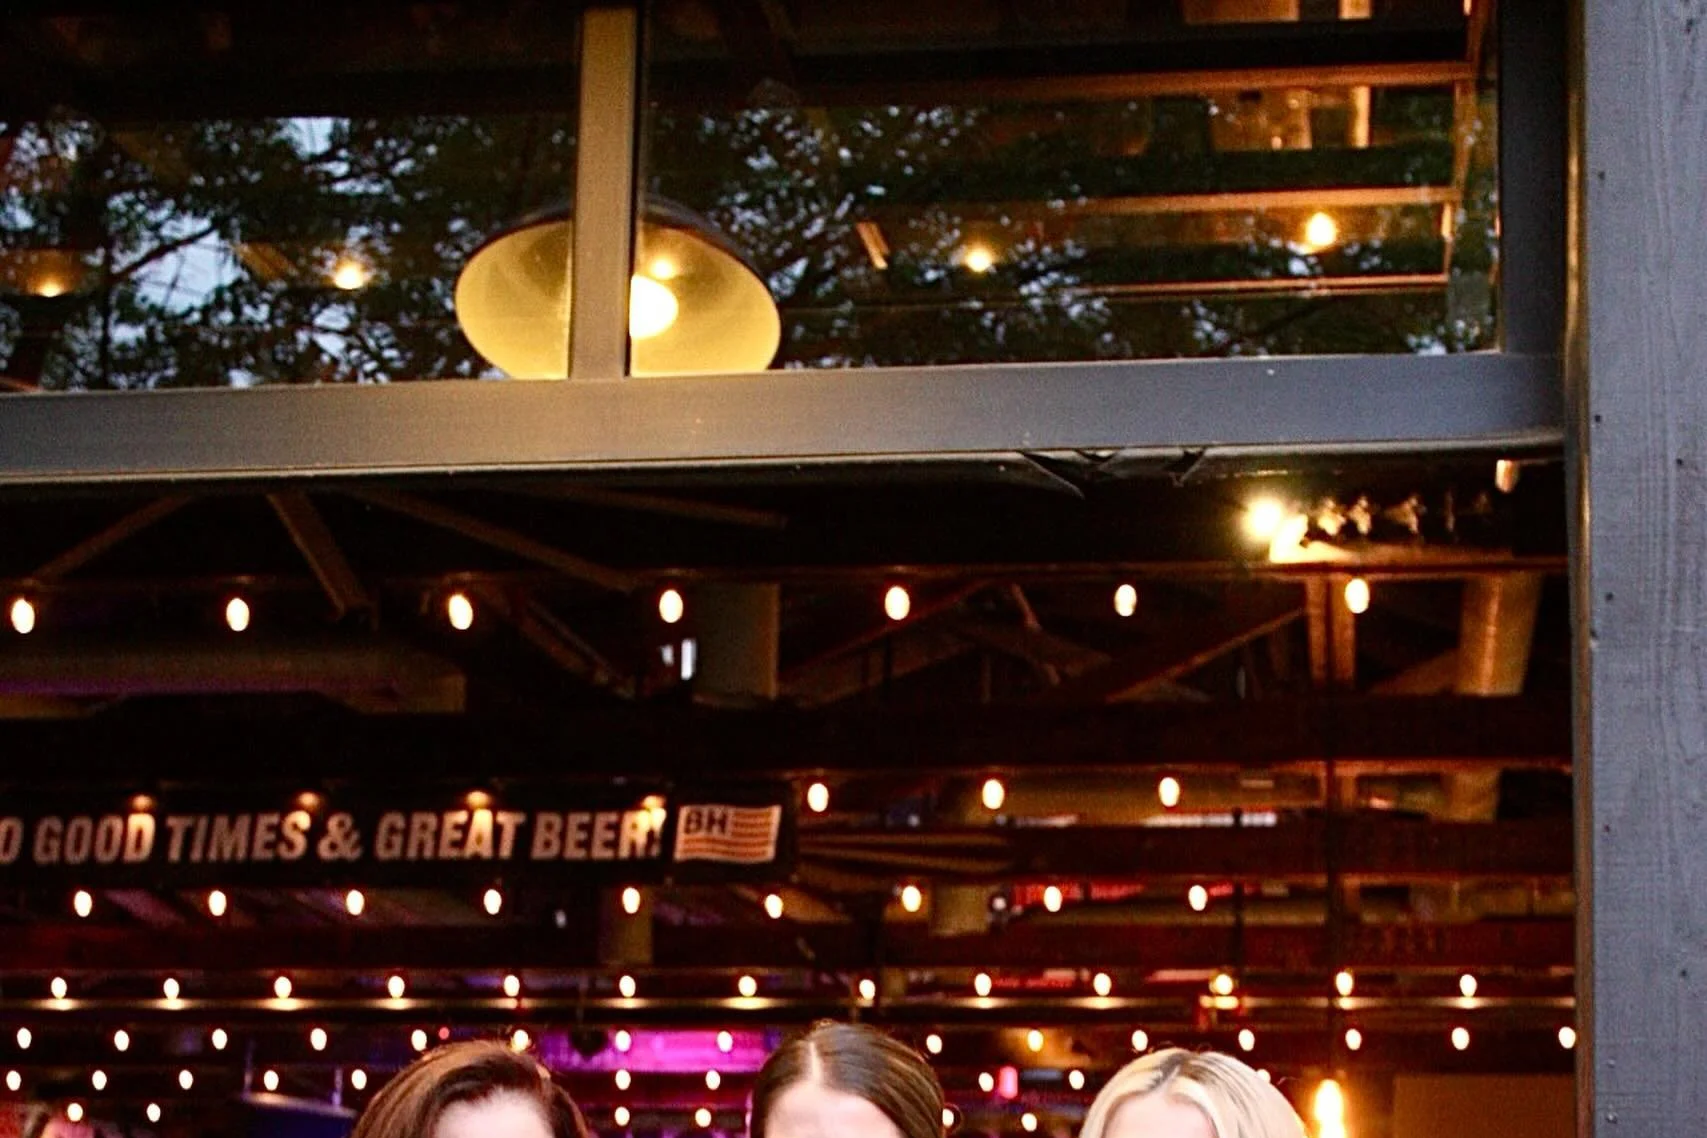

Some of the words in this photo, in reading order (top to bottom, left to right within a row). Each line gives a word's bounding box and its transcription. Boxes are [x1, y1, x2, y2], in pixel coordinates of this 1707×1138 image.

[33, 813, 156, 865] GOOD
[165, 810, 312, 863] TIMES
[317, 812, 363, 862] &
[375, 809, 526, 862] GREAT
[684, 808, 732, 836] BH
